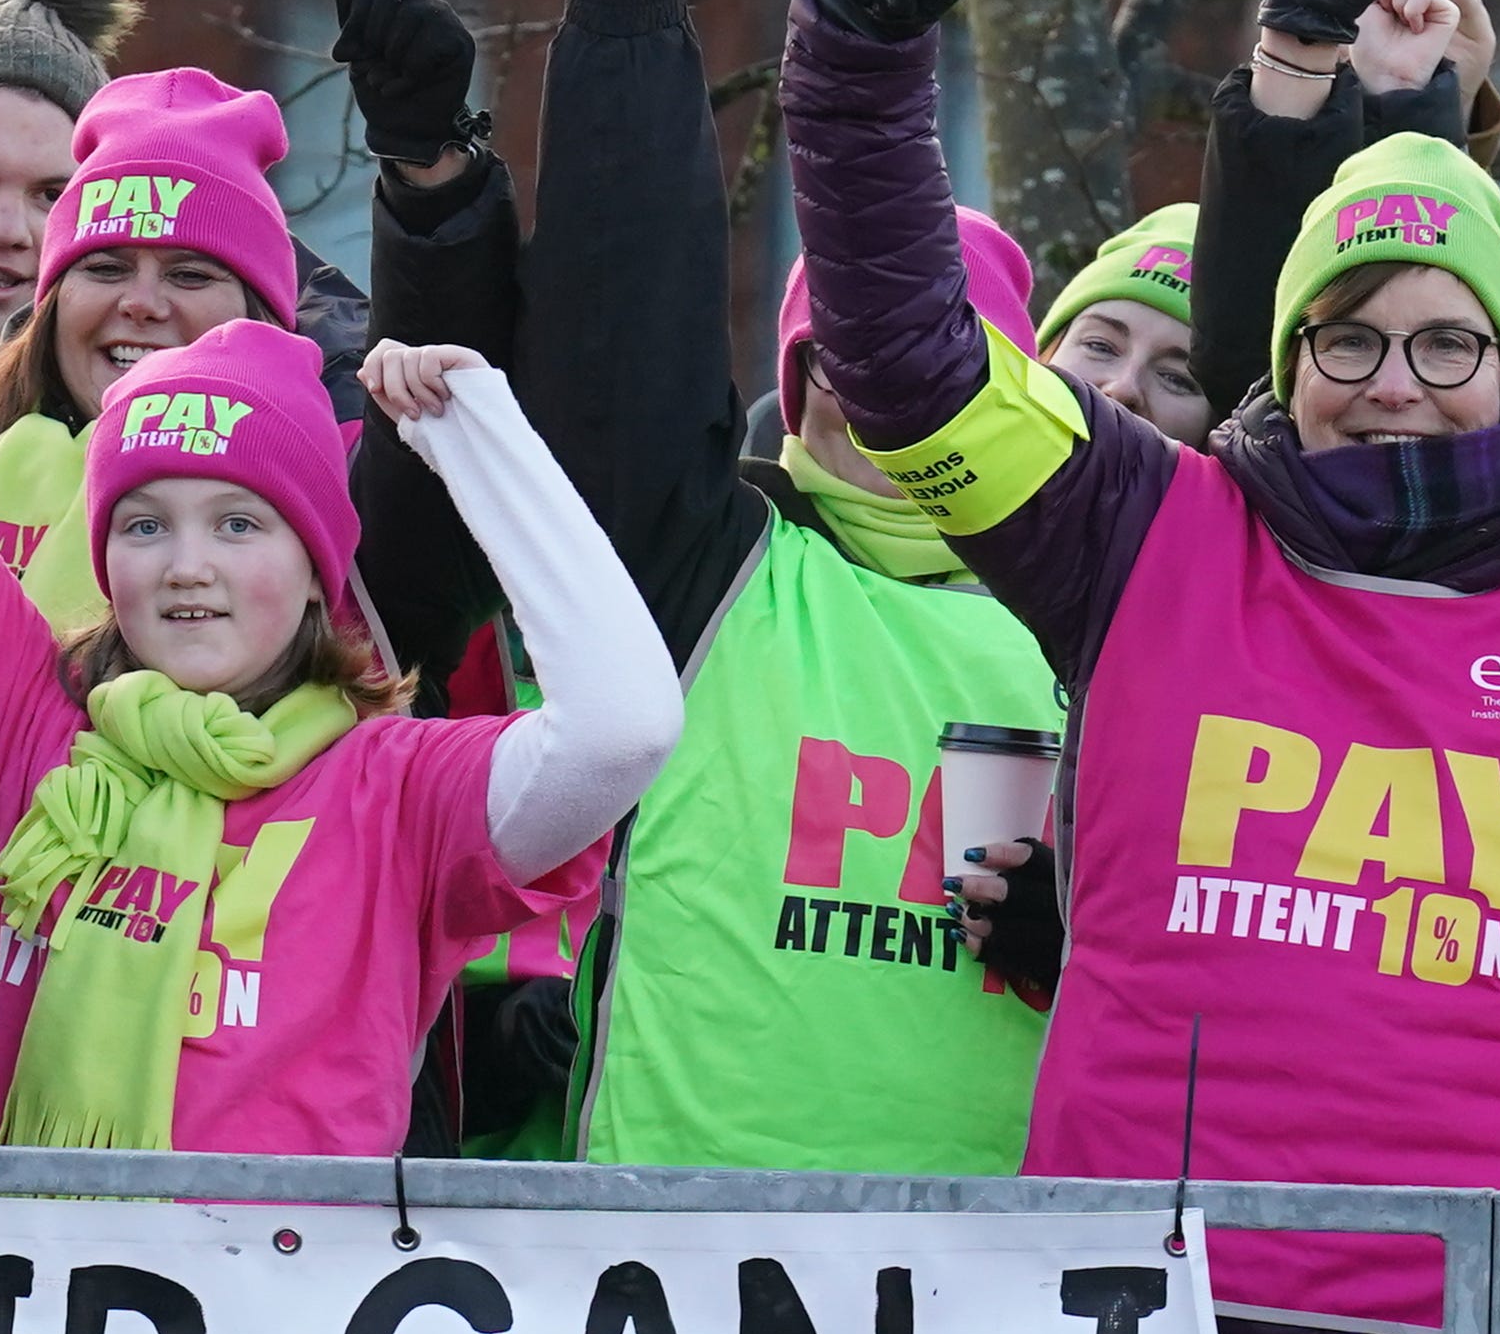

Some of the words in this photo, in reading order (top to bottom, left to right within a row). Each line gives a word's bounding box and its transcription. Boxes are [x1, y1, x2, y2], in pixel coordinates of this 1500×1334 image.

[76, 175, 196, 228] PAY
[1335, 194, 1460, 244] PAY
[121, 393, 254, 438] PAY
[907, 469, 978, 501] PICKET
[85, 865, 200, 924] PAY
